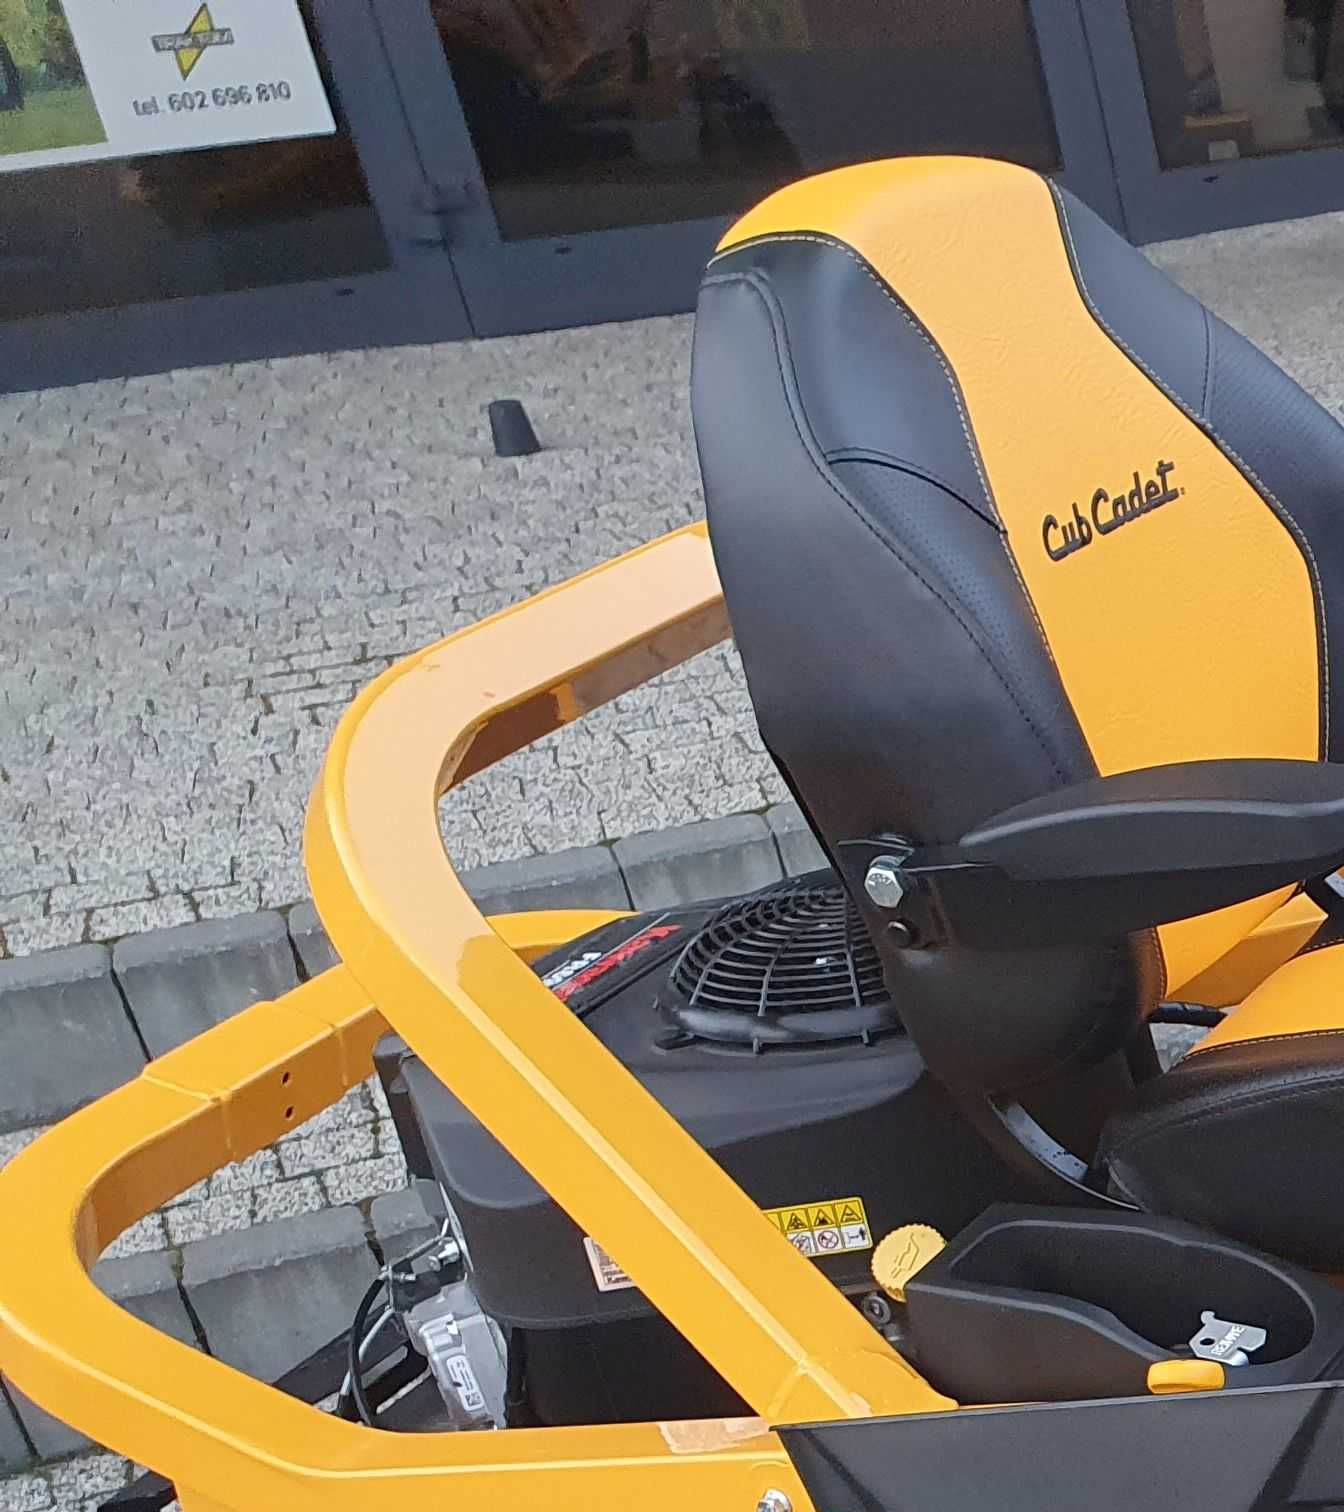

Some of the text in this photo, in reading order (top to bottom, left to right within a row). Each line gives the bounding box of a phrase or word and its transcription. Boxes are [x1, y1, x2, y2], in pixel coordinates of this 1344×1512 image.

[168, 91, 209, 113] 602
[1041, 460, 1180, 562] Cub Cadet
